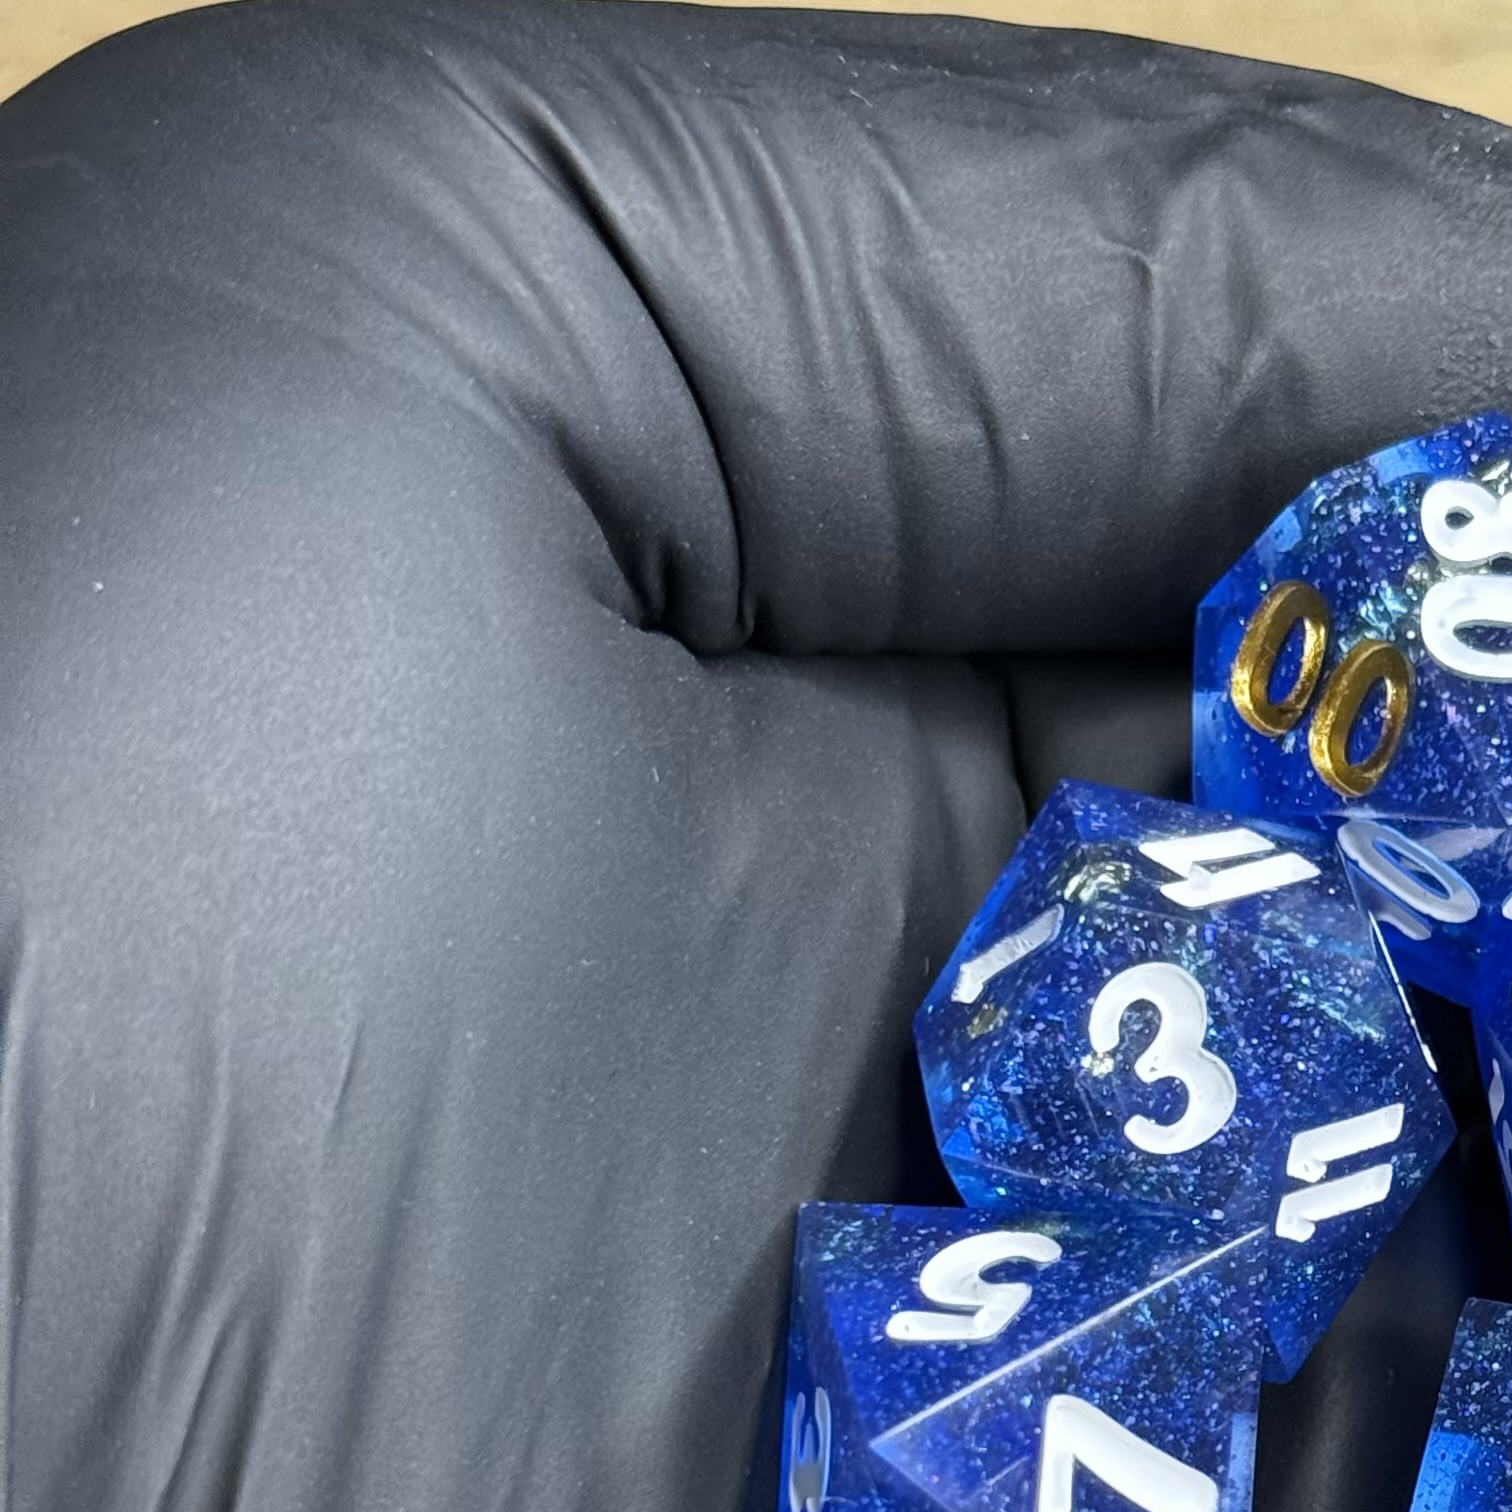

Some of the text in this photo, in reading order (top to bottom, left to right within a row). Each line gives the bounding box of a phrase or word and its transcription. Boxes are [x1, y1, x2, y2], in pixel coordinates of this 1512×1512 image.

[1231, 580, 1414, 798] 00
[1088, 962, 1237, 1154] 3
[1275, 1103, 1404, 1242] 11
[886, 1231, 1062, 1341] 5
